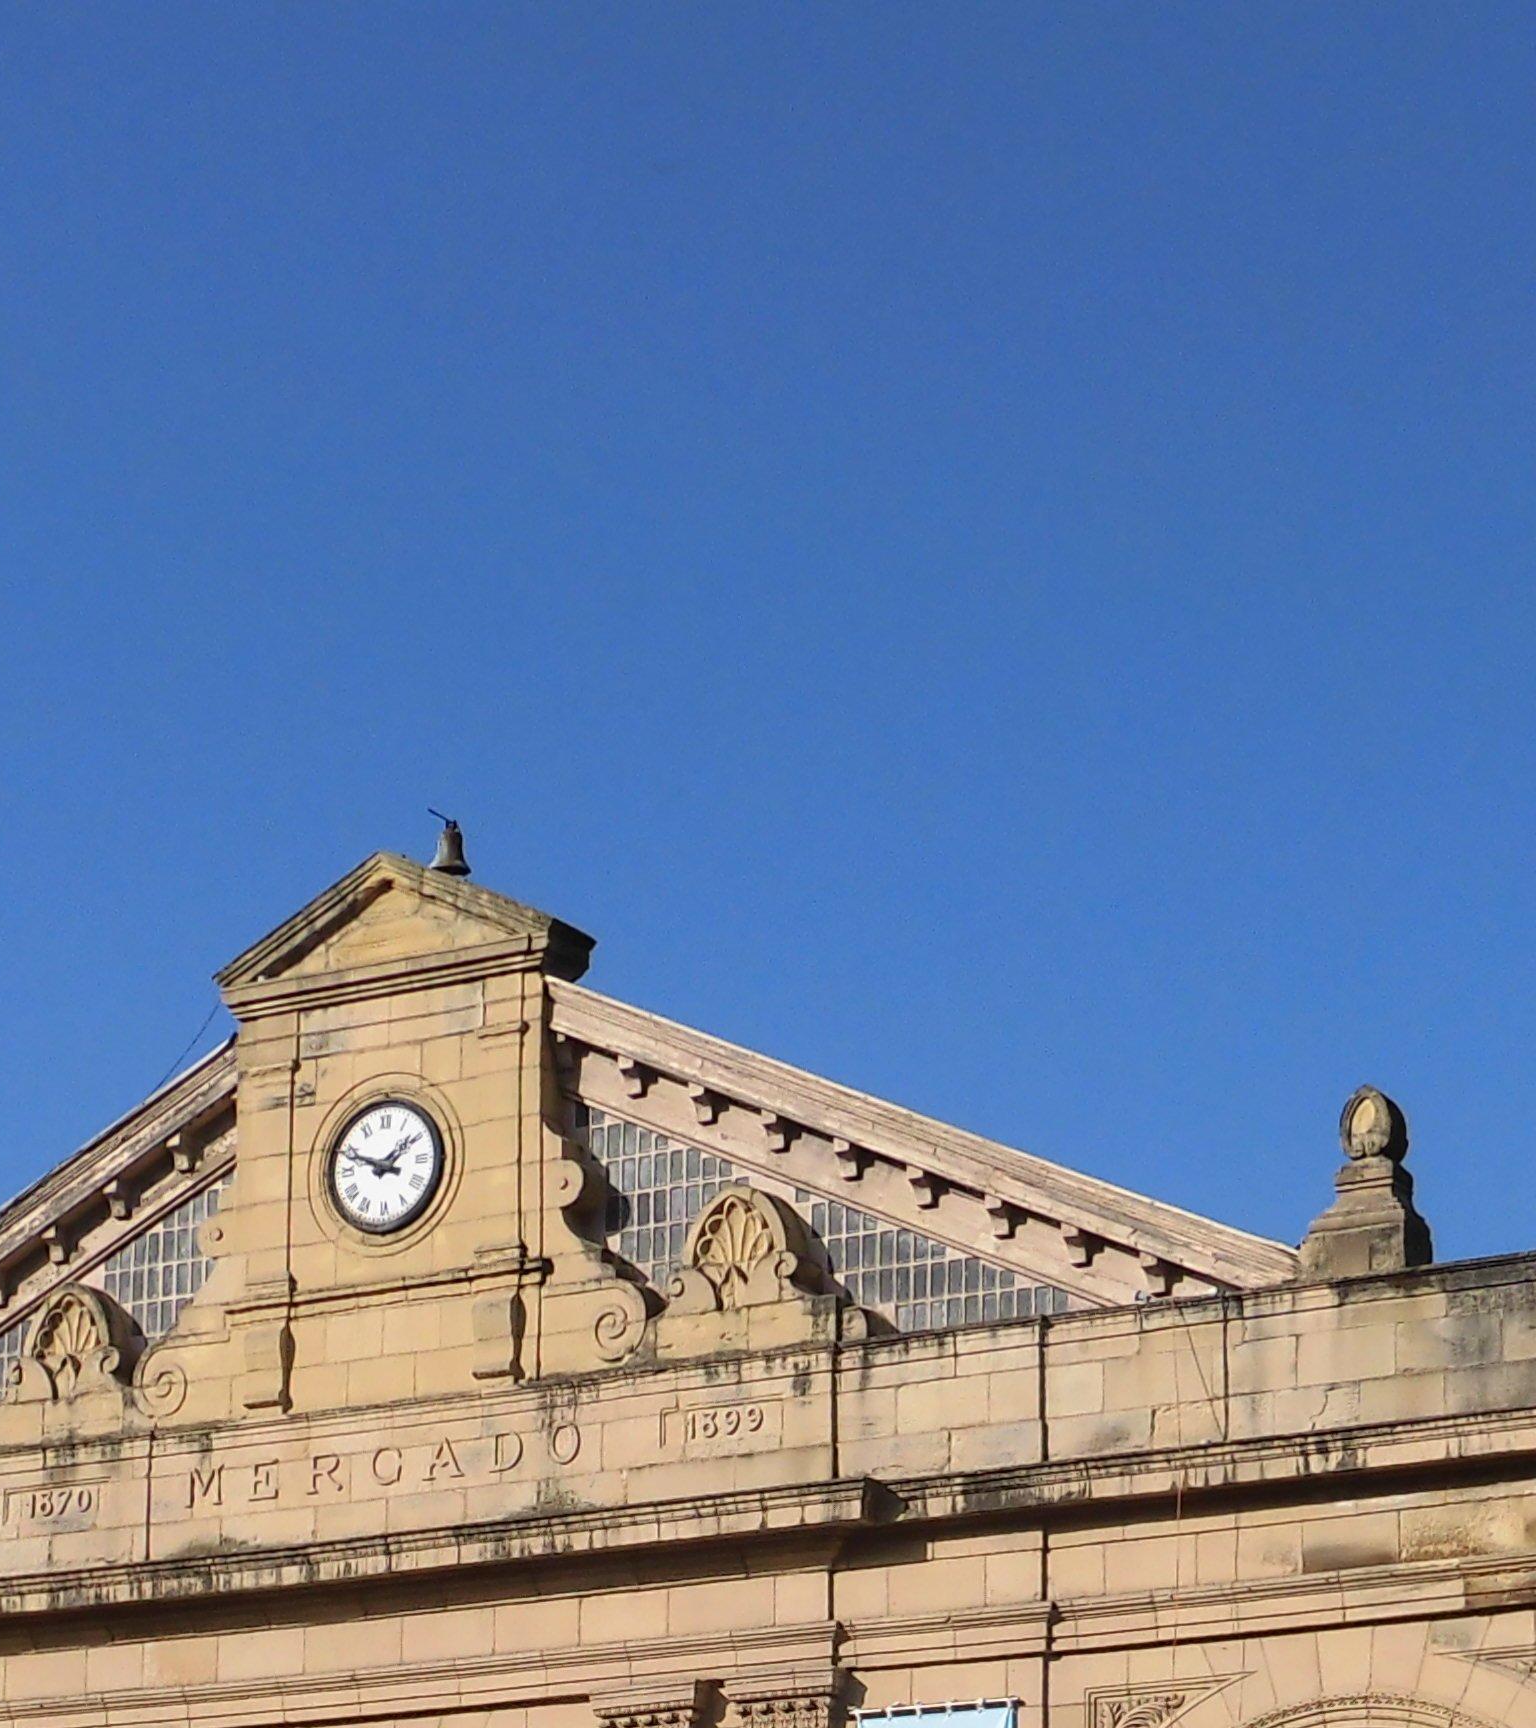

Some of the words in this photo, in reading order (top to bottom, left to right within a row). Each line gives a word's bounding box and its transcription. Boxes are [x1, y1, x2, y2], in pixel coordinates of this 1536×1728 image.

[687, 1405, 767, 1440] 1899
[184, 1422, 583, 1509] MERCADO
[27, 1487, 94, 1519] 1870
